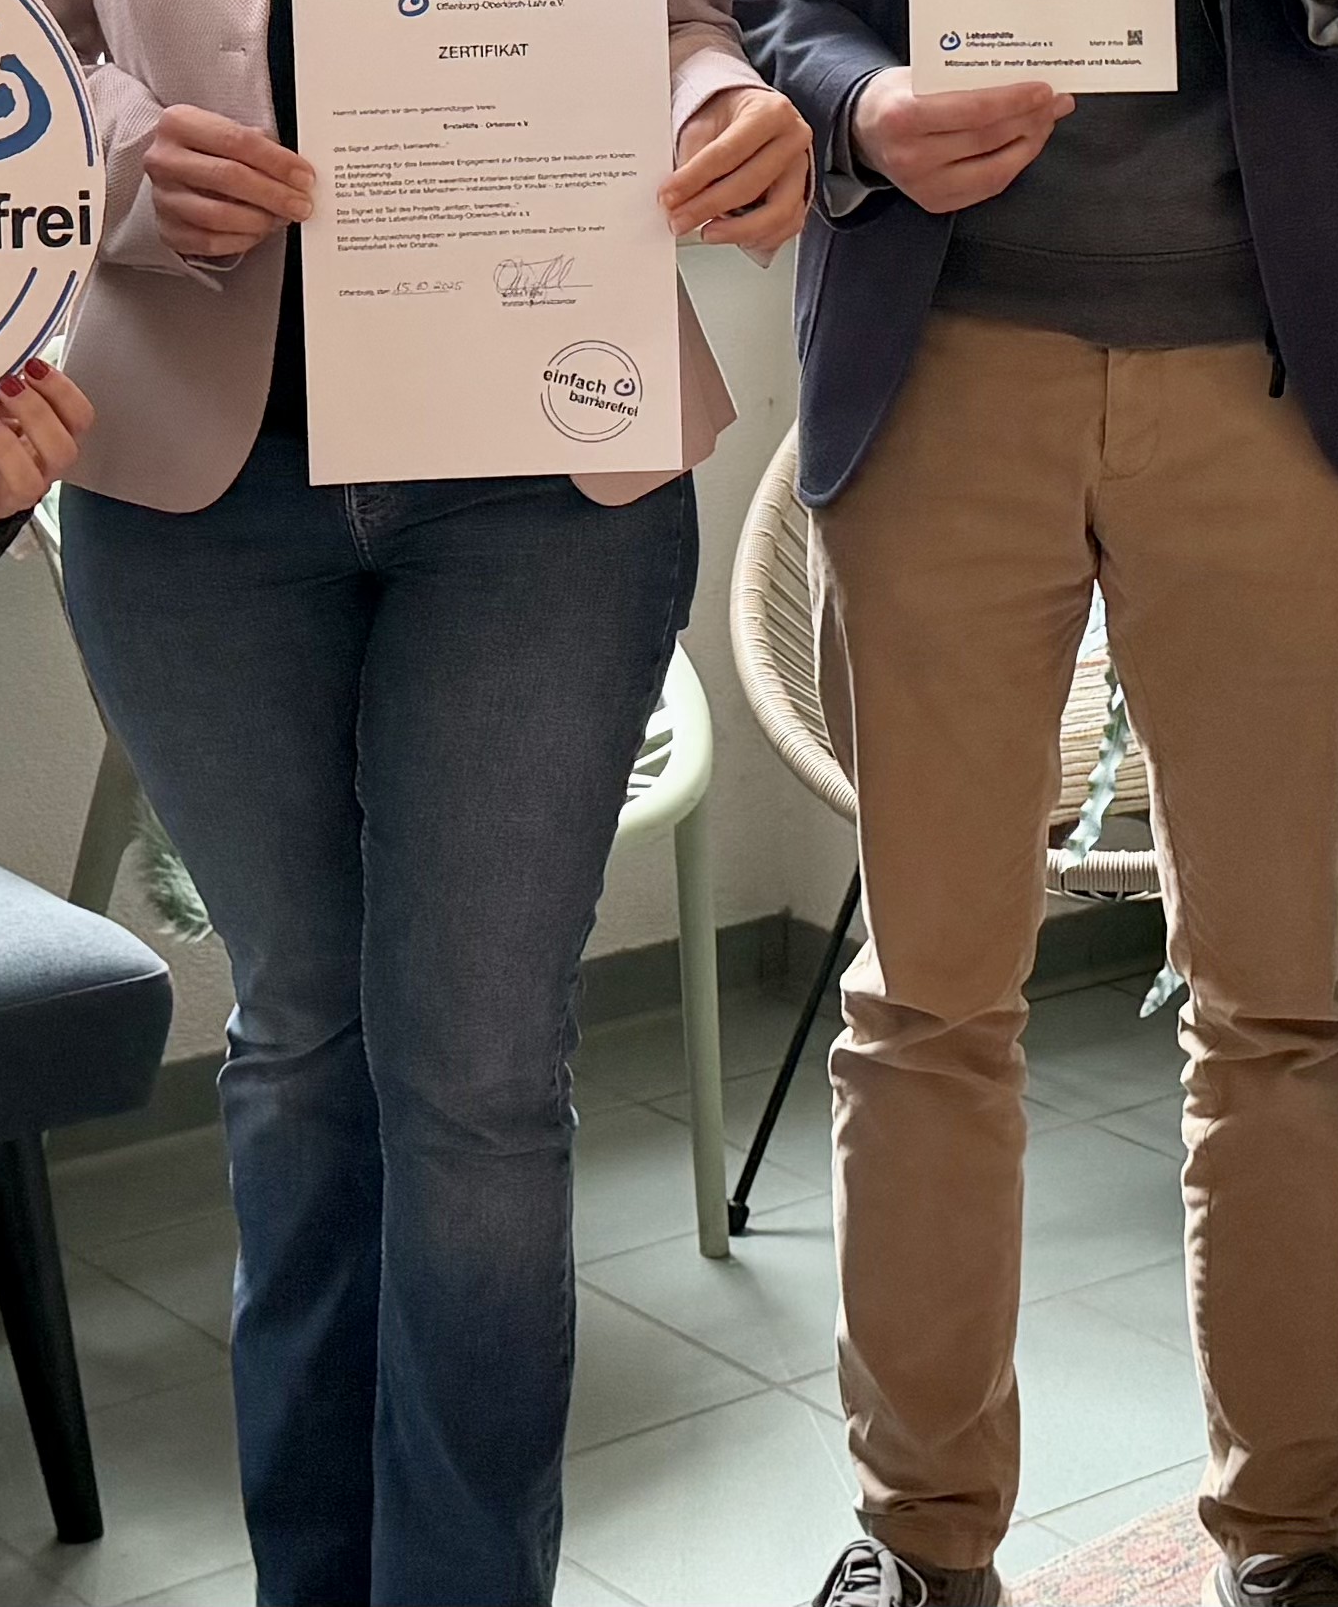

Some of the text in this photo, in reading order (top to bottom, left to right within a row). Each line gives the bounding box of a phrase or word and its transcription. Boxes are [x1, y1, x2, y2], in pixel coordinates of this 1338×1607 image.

[438, 43, 529, 59] ZERTIFIKAT
[543, 369, 607, 395] einfach
[569, 390, 638, 417] barrierefrei
